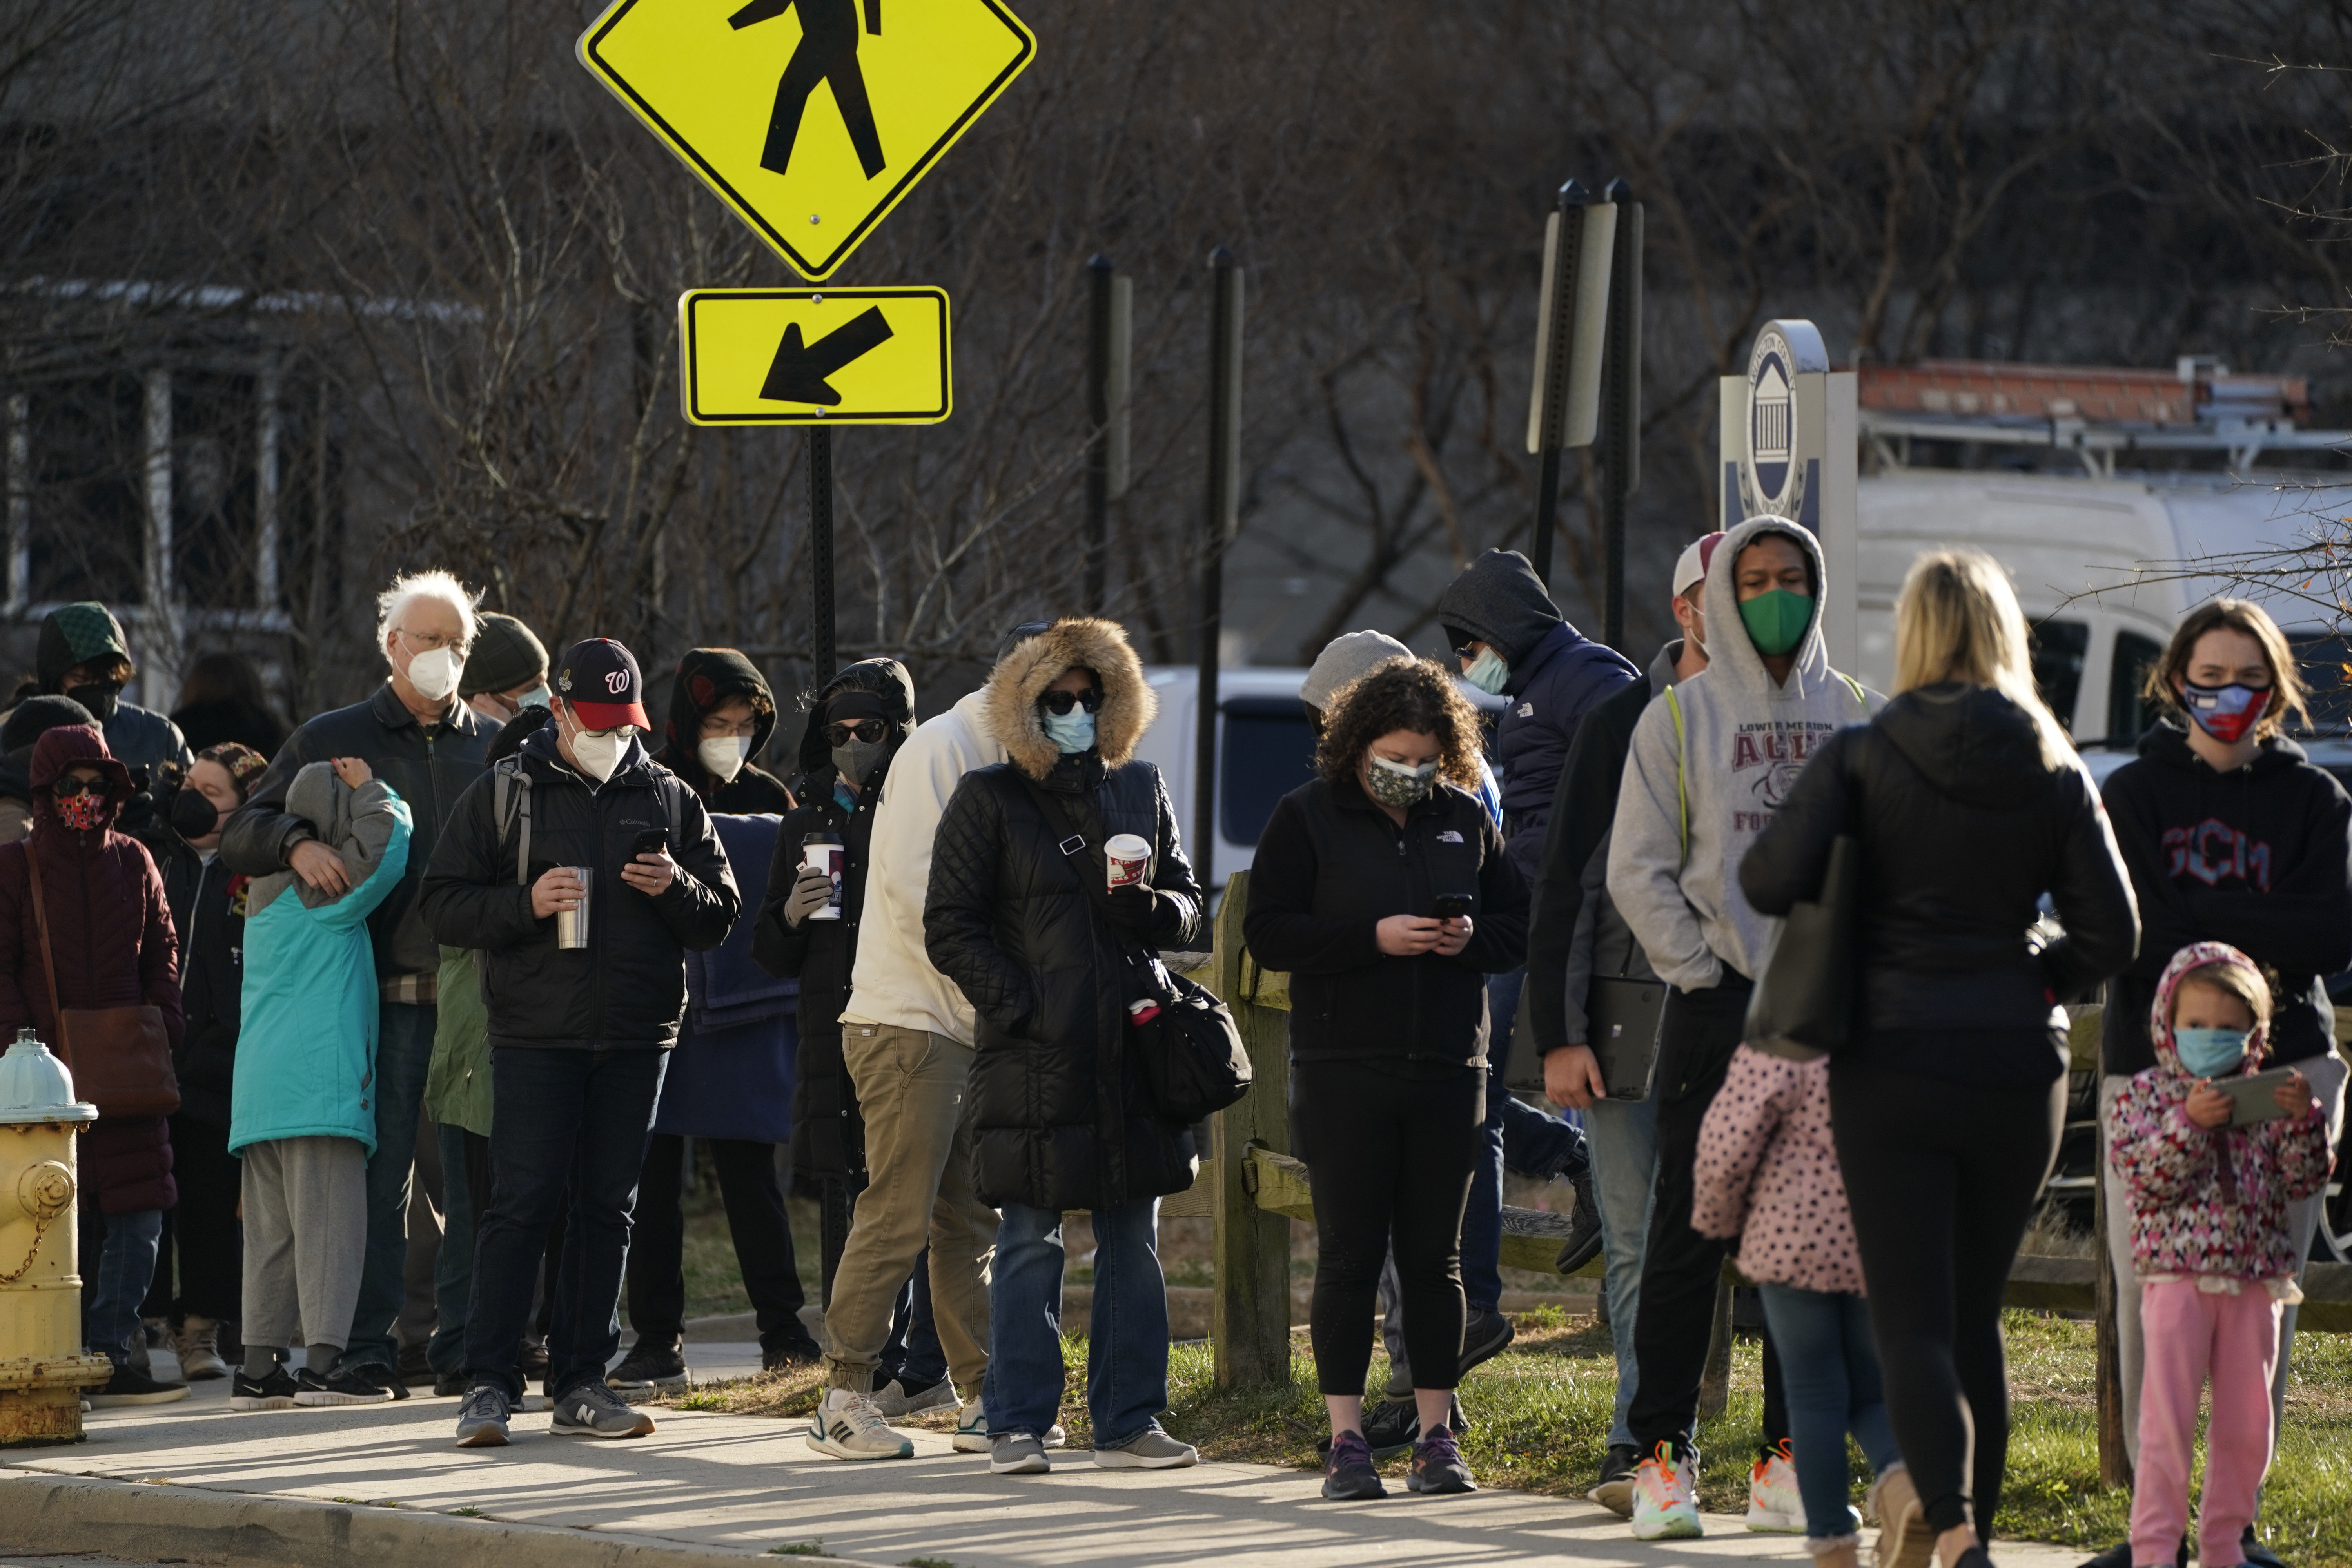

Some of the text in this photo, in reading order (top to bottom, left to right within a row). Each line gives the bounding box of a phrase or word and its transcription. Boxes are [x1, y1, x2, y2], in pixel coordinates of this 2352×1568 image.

[605, 669, 630, 694] W
[1739, 722, 1783, 732] LOWER
[1786, 721, 1833, 731] MERION
[626, 818, 650, 827] Columbia
[576, 1403, 596, 1426] N
